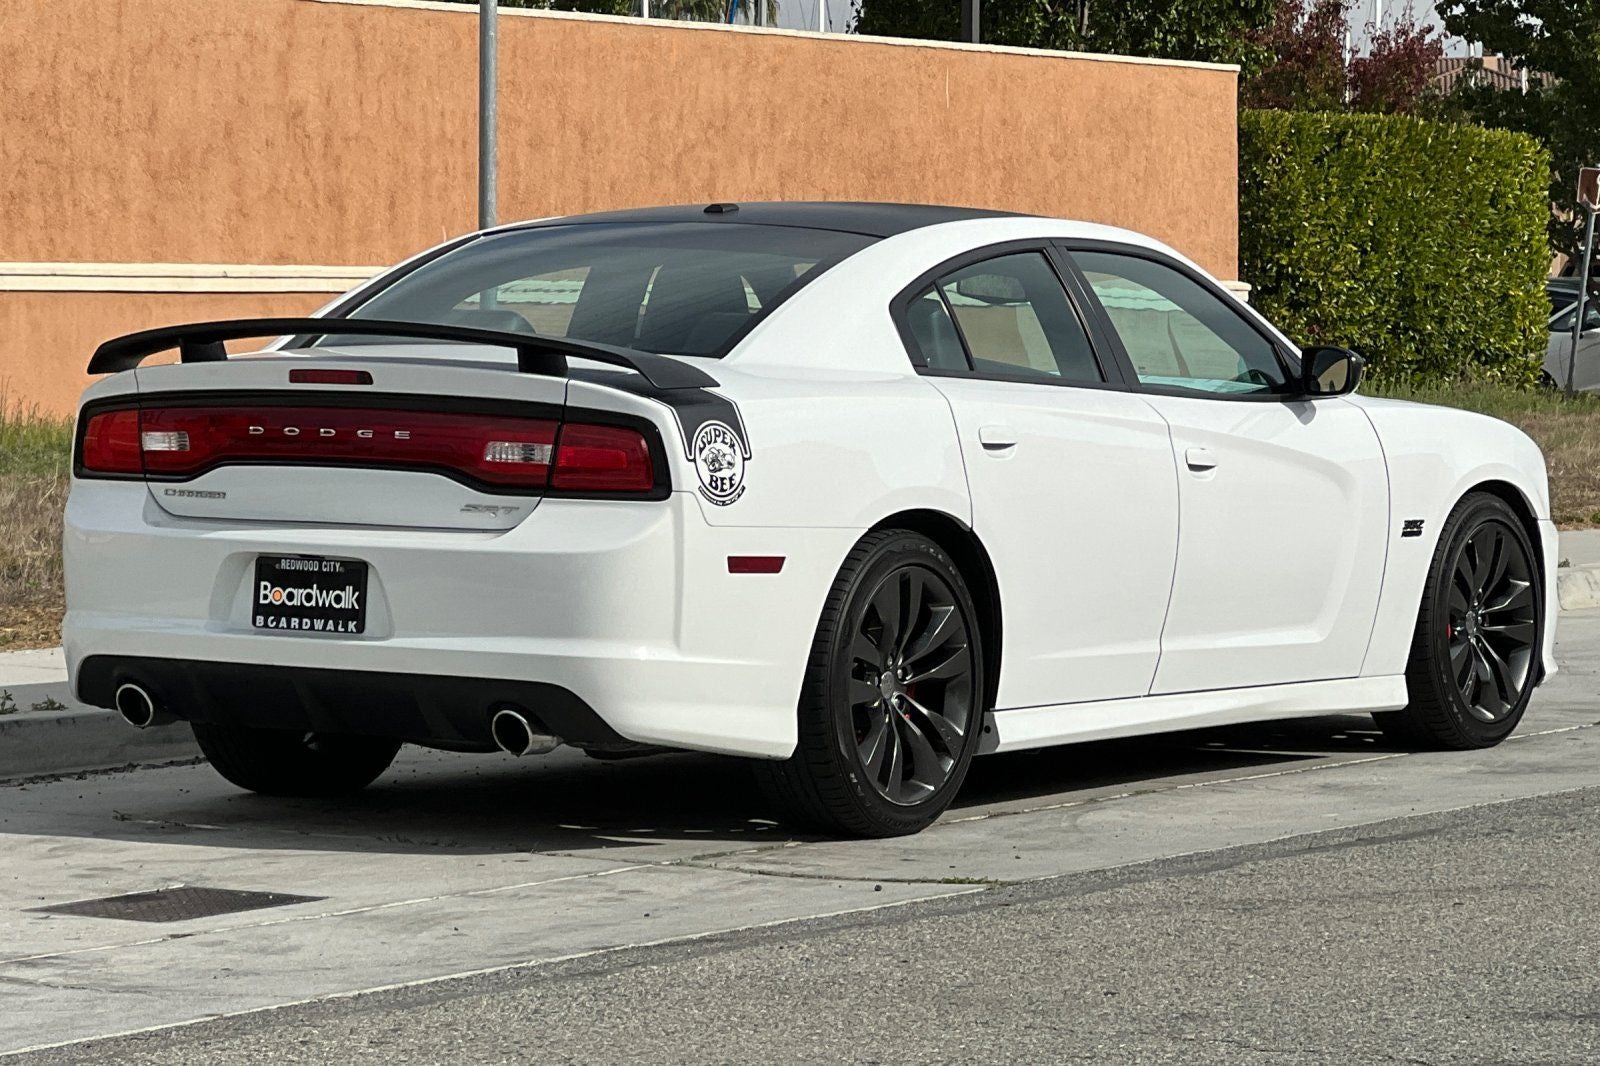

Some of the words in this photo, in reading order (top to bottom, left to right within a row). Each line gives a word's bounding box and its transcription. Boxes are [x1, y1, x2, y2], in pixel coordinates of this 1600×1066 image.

[249, 426, 411, 439] DODGE
[699, 427, 737, 457] SUPER
[708, 473, 737, 492] BEE
[280, 559, 319, 572] REDWOOD
[322, 561, 341, 573] CITY
[259, 581, 360, 610] Boardwalk
[255, 615, 358, 633] BOARDWALK
